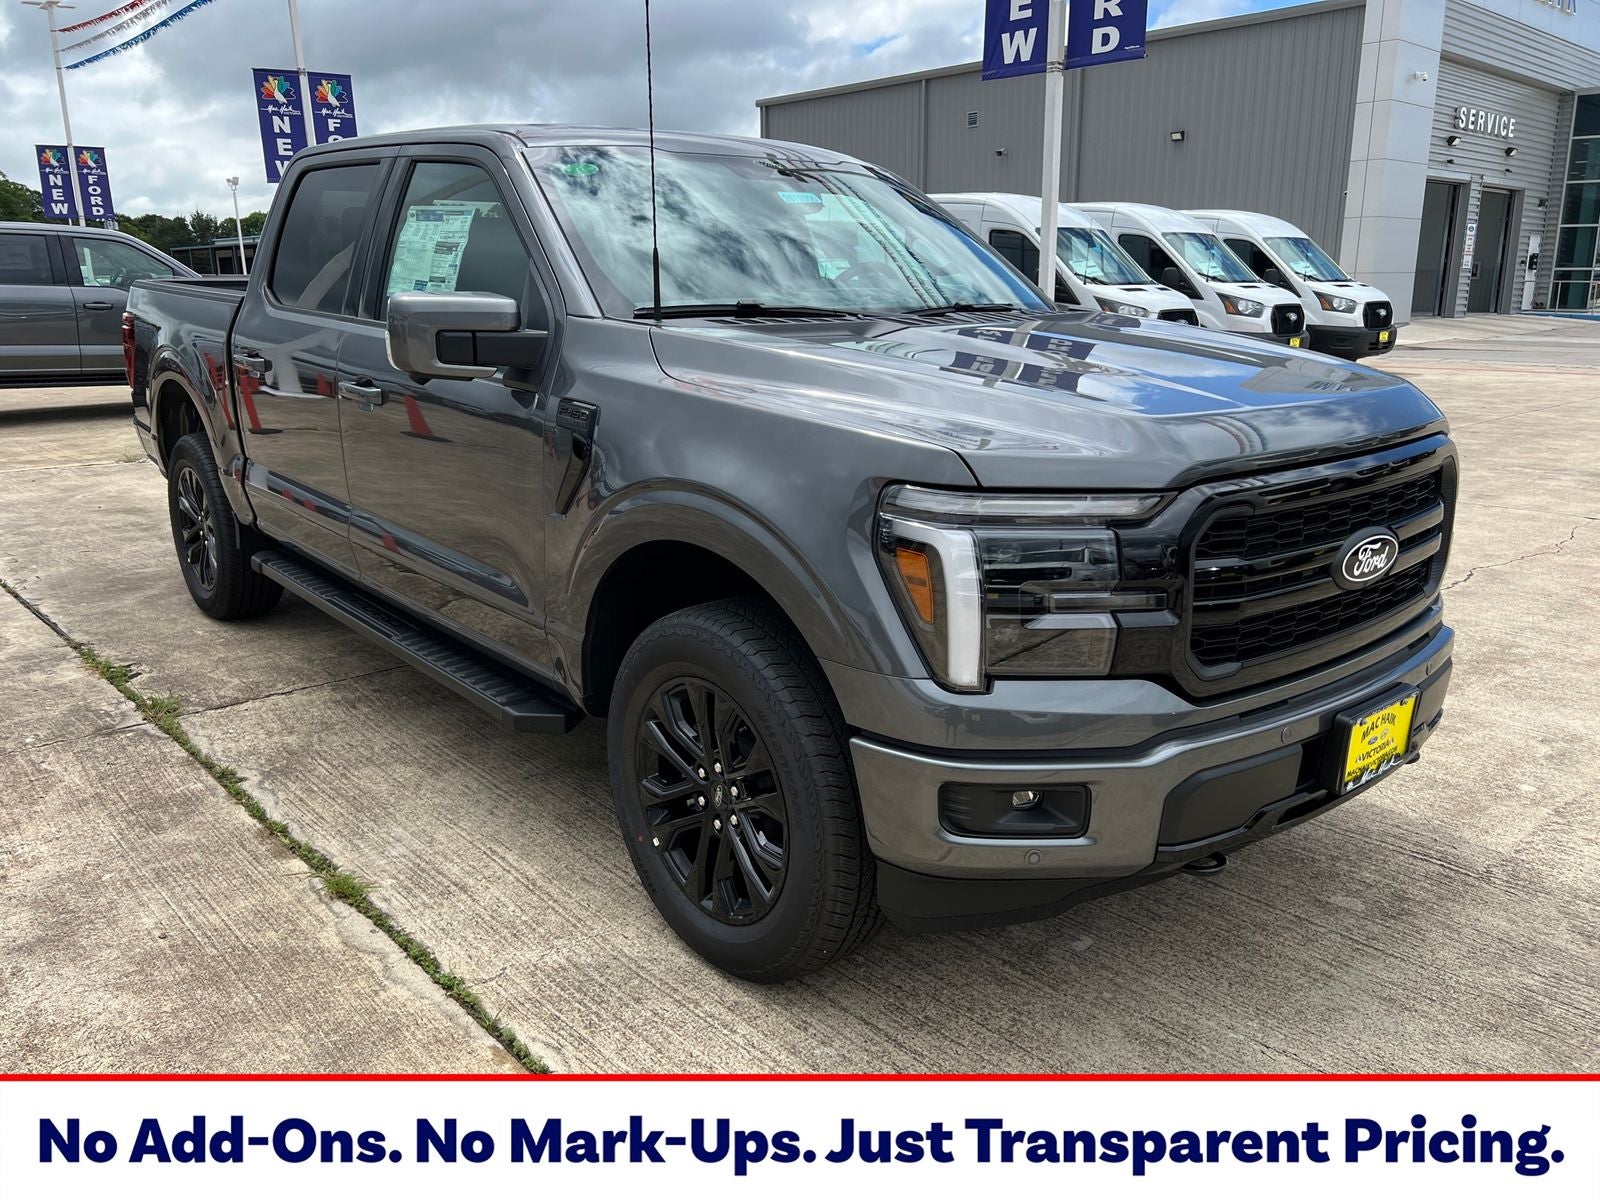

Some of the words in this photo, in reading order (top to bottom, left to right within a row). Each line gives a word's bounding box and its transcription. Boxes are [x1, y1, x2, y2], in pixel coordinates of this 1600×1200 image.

[1001, 0, 1038, 65] EW
[1091, 0, 1123, 55] RD
[1459, 106, 1516, 138] SERVICE
[48, 174, 68, 215] NEW
[87, 175, 104, 216] FORD
[1353, 541, 1390, 577] Ford
[1361, 716, 1380, 742] MAC
[1381, 712, 1397, 727] HAIK
